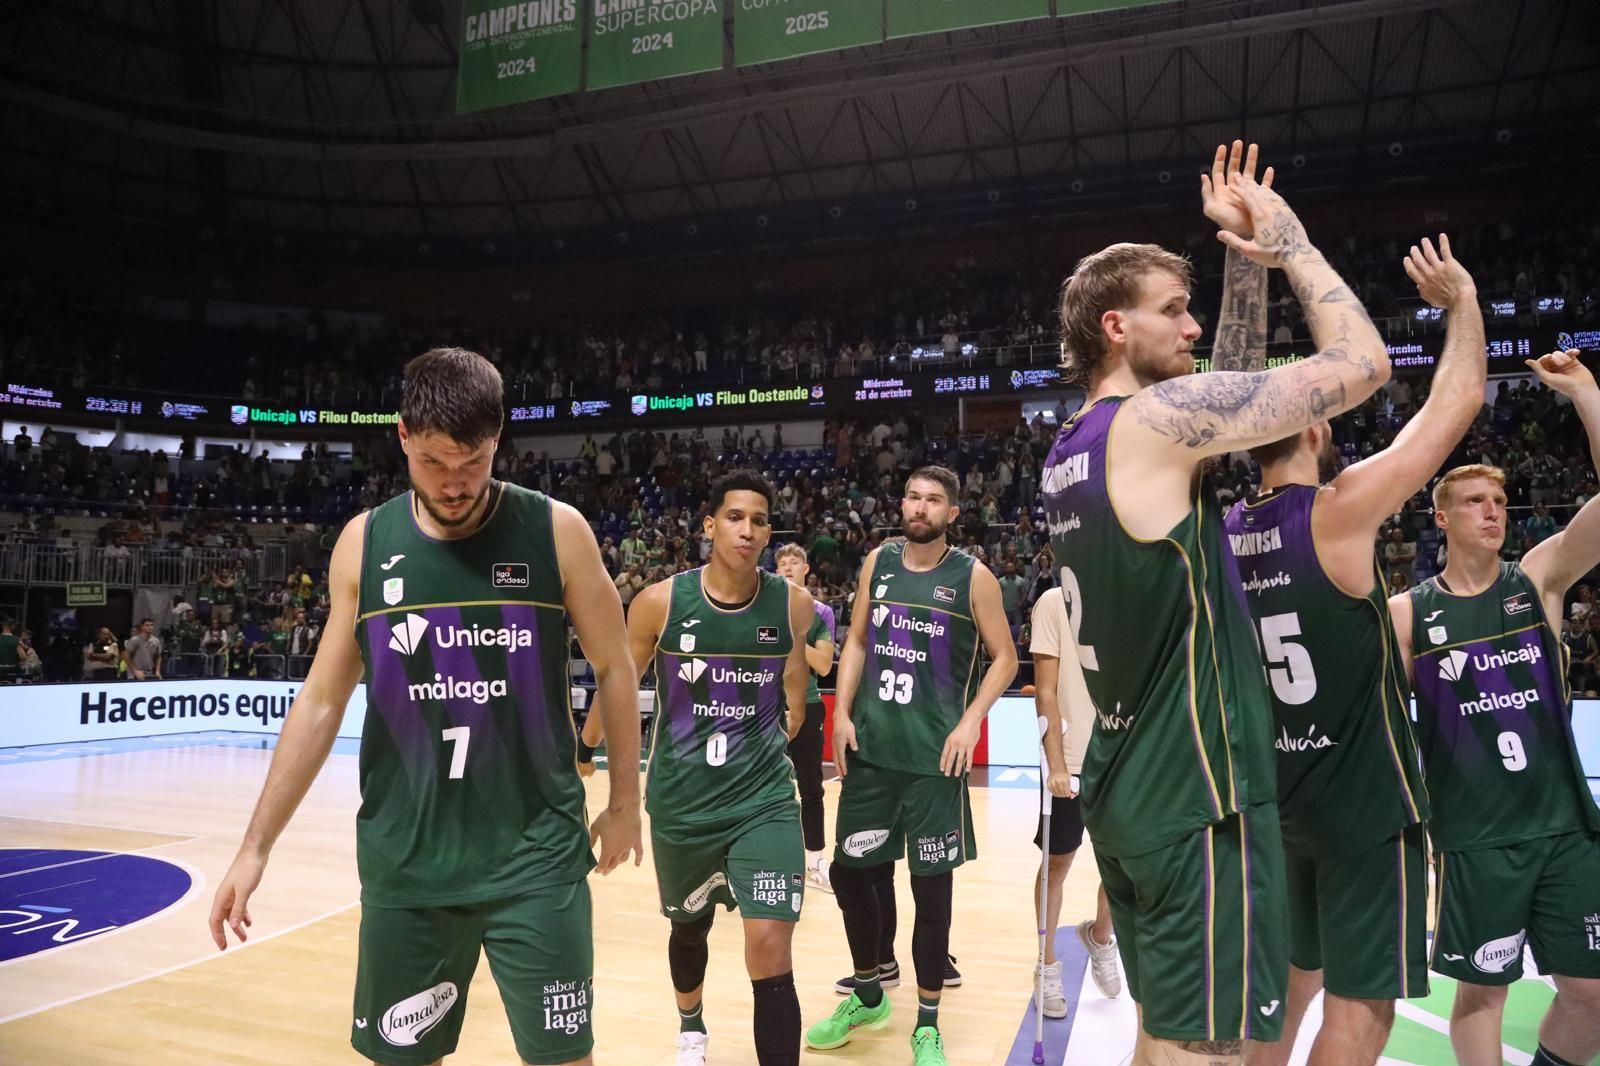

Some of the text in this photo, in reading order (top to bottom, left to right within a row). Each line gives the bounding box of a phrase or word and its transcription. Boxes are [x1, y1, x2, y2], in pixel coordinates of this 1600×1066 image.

[465, 0, 577, 42] CAMPEONES
[594, 0, 718, 35] SUPERCOPA
[785, 11, 829, 34] 2025
[632, 31, 673, 54] 2024
[497, 56, 537, 79] 2024
[1518, 339, 1530, 356] H
[1395, 355, 1434, 366] octubre
[934, 376, 990, 394] 20:30 H
[86, 397, 142, 415] 20:30 H
[649, 386, 809, 411] Unicaja VS Filou Oostende
[250, 408, 400, 426] Unicaja VS Filou Oostend
[510, 404, 555, 421] 20:30 H
[495, 567, 511, 579] liga
[495, 576, 527, 587] endesa
[891, 614, 945, 638] Unicaja
[435, 624, 533, 654] Unicaja
[1251, 612, 1318, 706] 5
[1473, 643, 1542, 671] Unicaja
[711, 668, 775, 689] Unicaja
[878, 669, 914, 704] 33
[80, 688, 295, 726] Hacemos equi
[442, 725, 471, 780] 7
[706, 731, 728, 768] 0
[1496, 731, 1528, 772] 9
[753, 888, 787, 907] laga
[542, 980, 578, 996] sabor
[385, 985, 455, 1038] famadesa
[543, 1008, 589, 1037] laga
